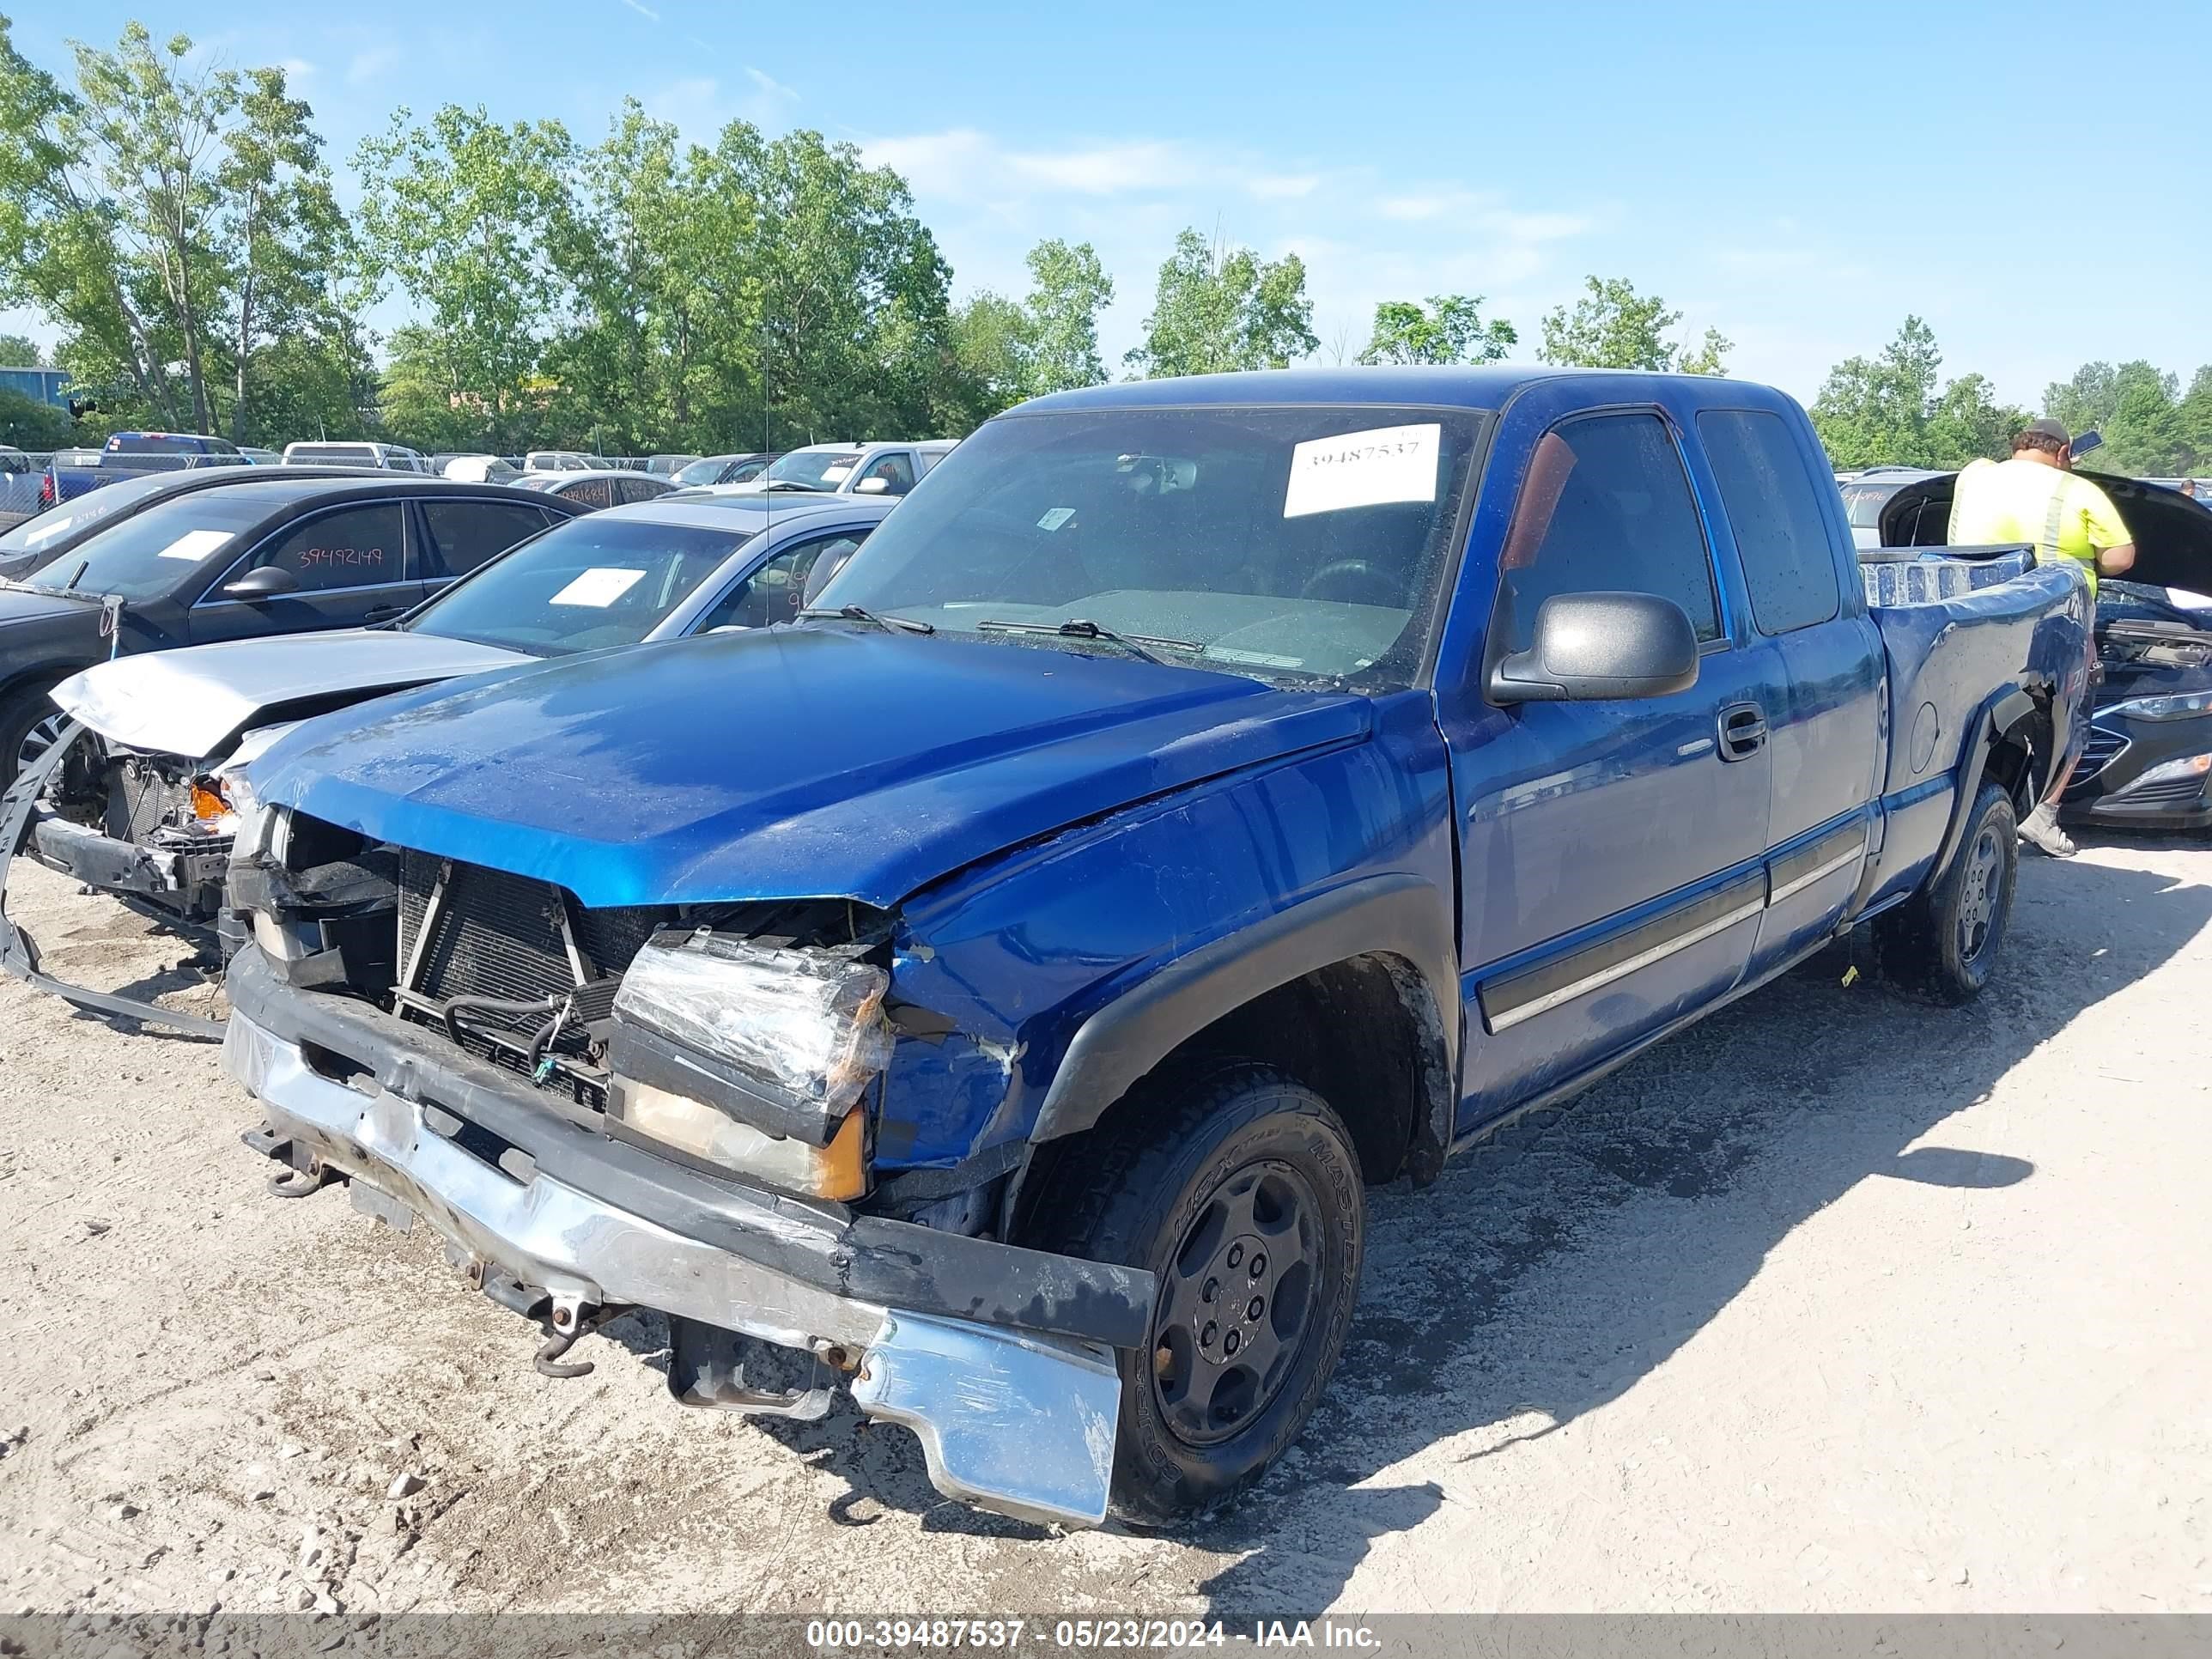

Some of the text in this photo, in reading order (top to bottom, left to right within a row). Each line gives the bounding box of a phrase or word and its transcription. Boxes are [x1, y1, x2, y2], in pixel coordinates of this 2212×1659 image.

[1306, 441, 1420, 471] 39487537
[561, 487, 606, 501] 9481684
[297, 548, 383, 568] 39492149
